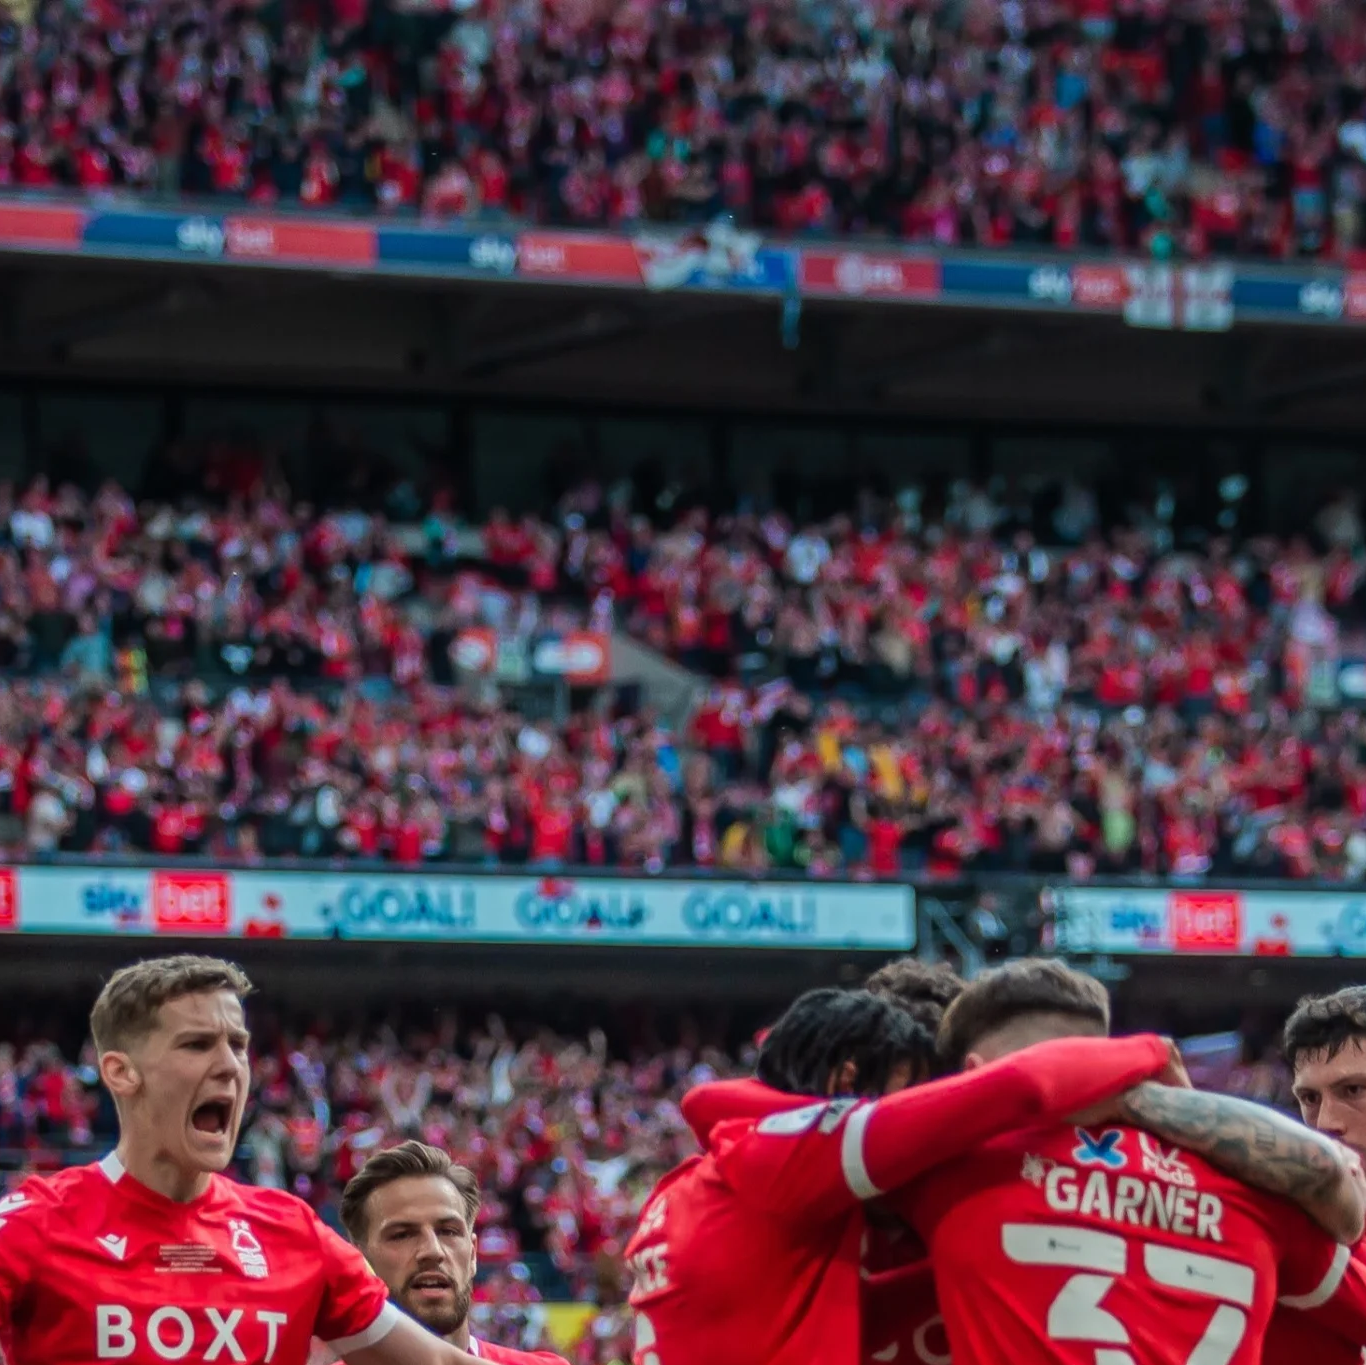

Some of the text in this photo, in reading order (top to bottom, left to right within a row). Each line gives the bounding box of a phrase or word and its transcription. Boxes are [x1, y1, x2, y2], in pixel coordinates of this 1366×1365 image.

[159, 879, 224, 917] bet
[1045, 1166, 1223, 1242] GARNER
[96, 1304, 288, 1363] BOXT
